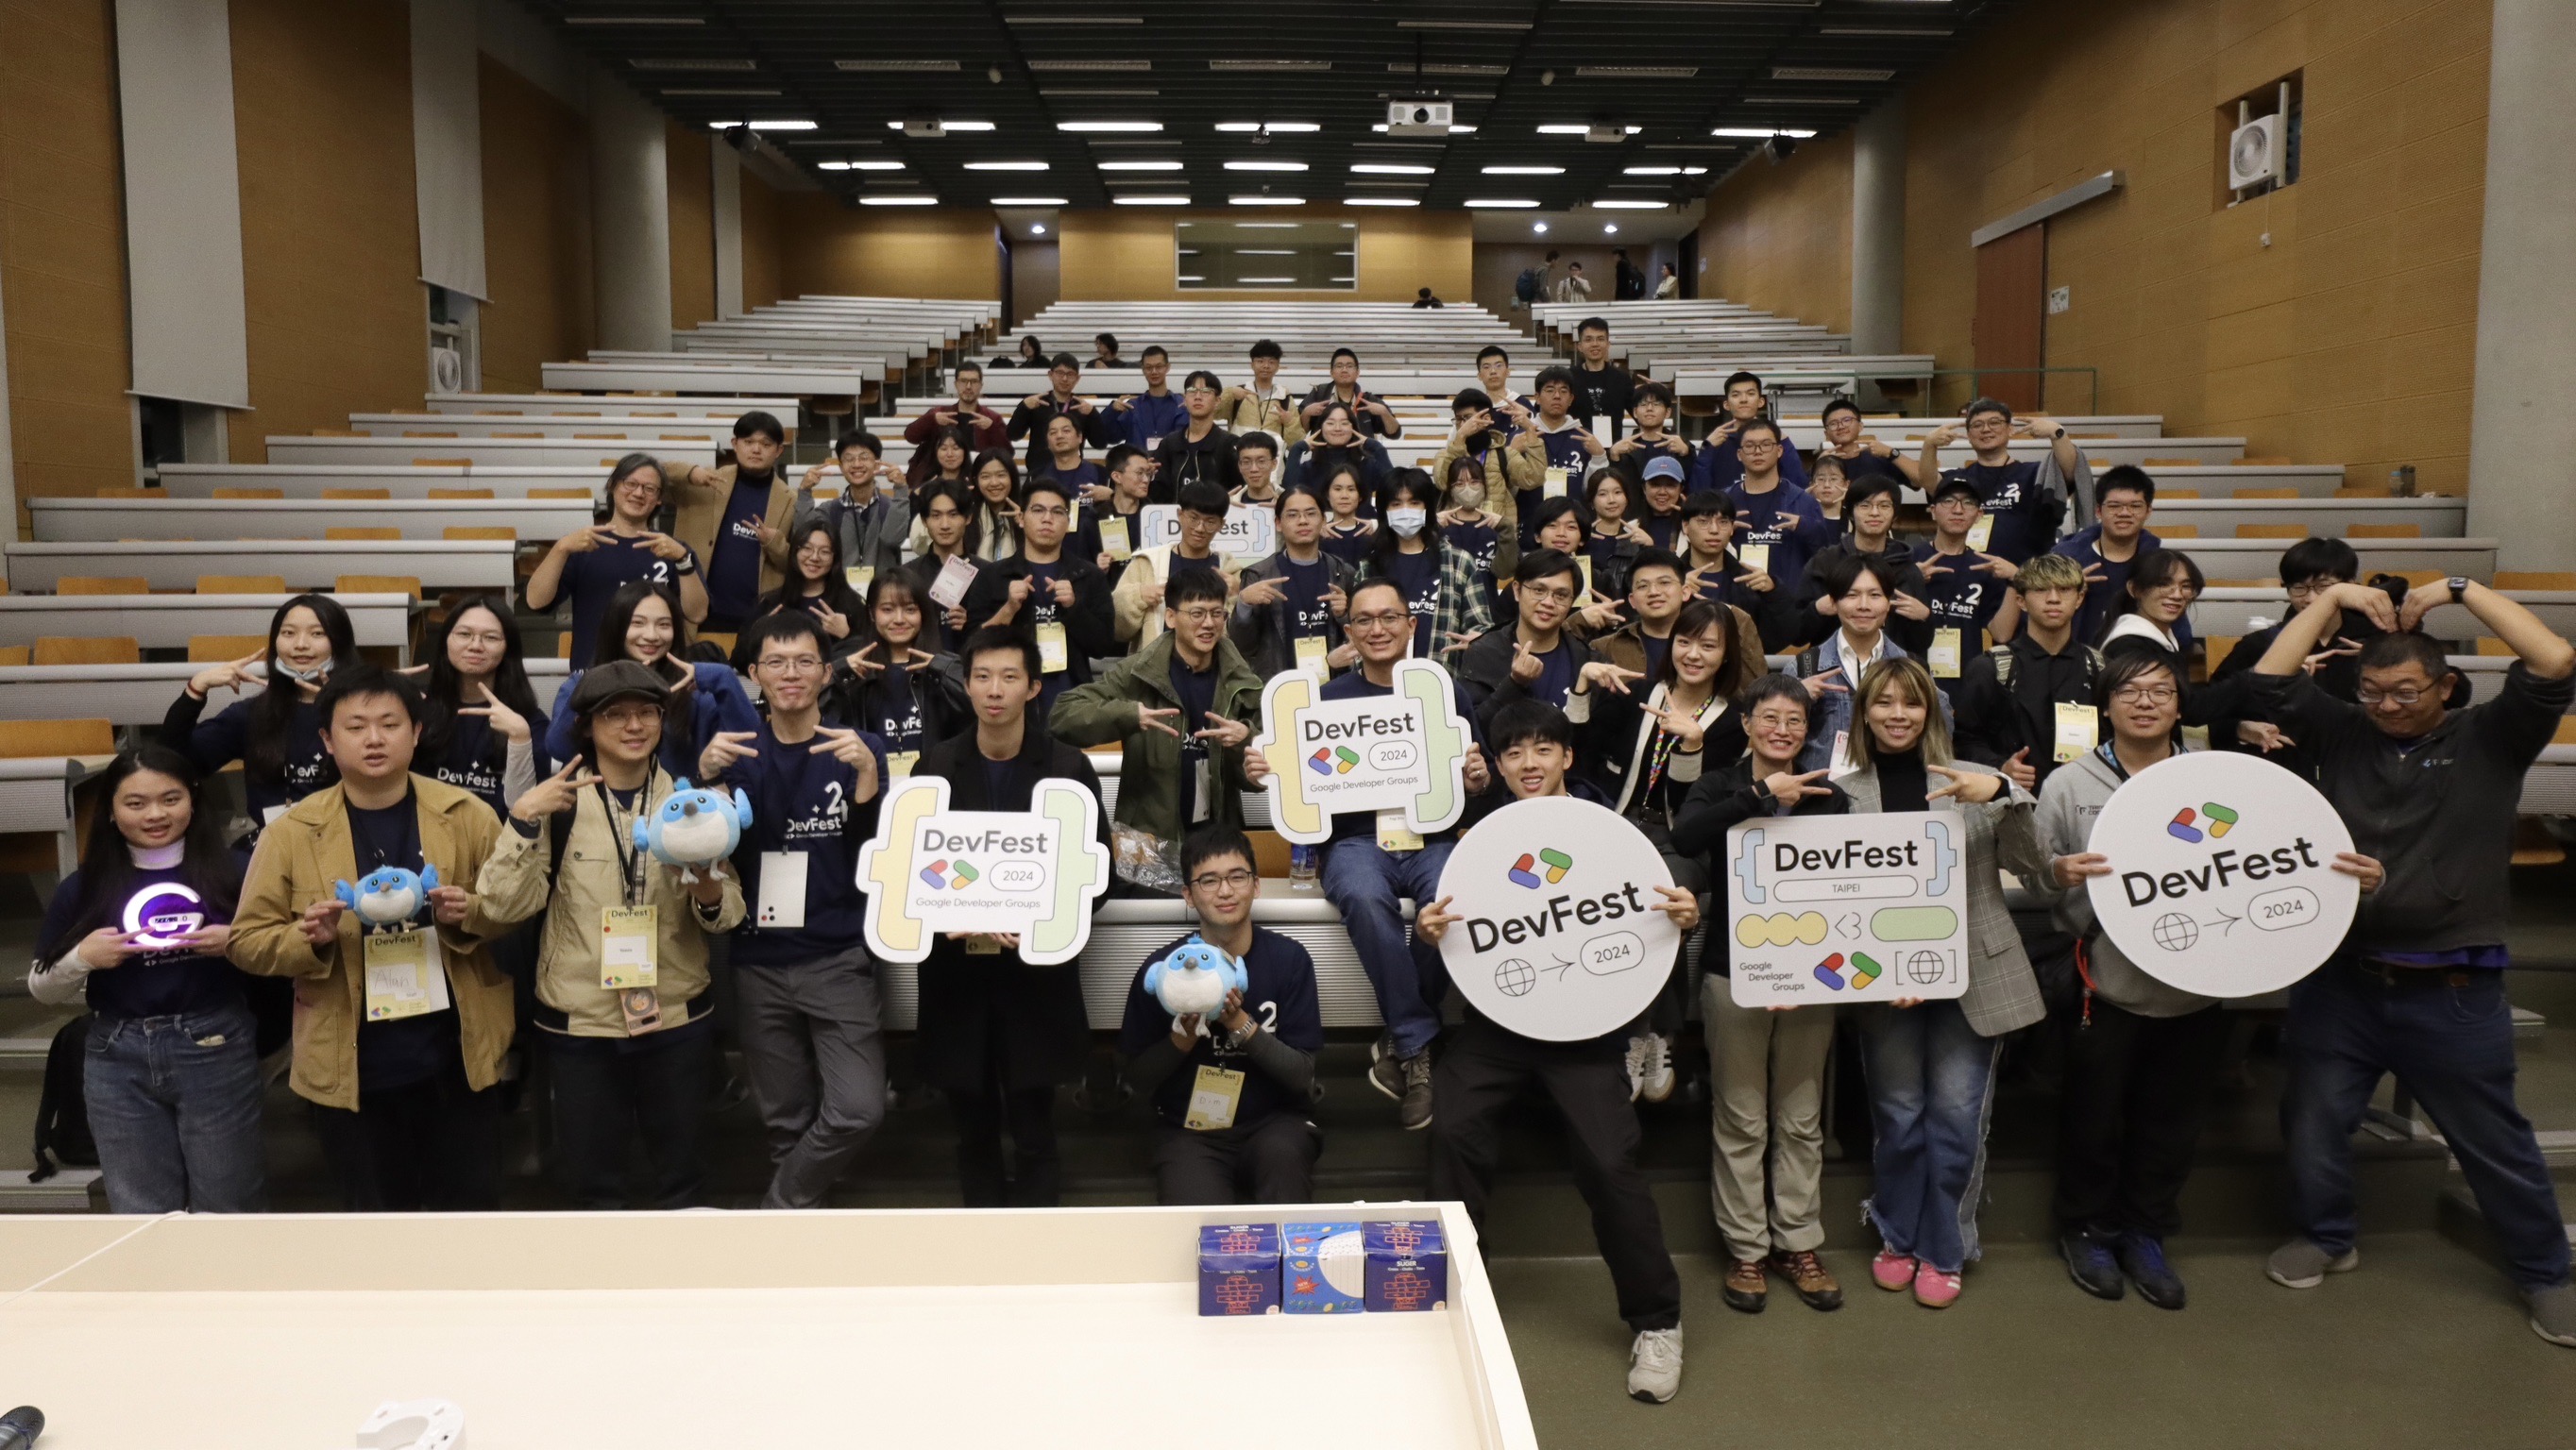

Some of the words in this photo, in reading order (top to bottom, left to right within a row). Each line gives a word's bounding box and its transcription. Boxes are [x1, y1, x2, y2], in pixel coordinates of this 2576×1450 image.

[1986, 497, 2012, 506] evFest
[1168, 518, 1249, 536] Dest
[1409, 598, 1435, 611] evFes
[1305, 713, 1415, 742] DevFest
[1381, 750, 1408, 762] 2024
[1310, 783, 1342, 794] Google
[1343, 780, 1385, 790] Developer
[1387, 776, 1419, 786] Groups
[924, 829, 1048, 853] DevFest
[1775, 840, 1919, 872] DevFest
[1003, 869, 1034, 882] 2024
[2122, 837, 2320, 907] DevFest
[1832, 884, 1861, 893] TAIPEI
[916, 897, 952, 908] Google
[954, 898, 1003, 908] Developer
[1005, 899, 1042, 909] Groups
[2263, 900, 2304, 919] 2024
[1466, 882, 1645, 953] DevFest
[1594, 944, 1631, 963] 2024
[1739, 961, 1772, 972] Google
[1748, 971, 1794, 983] Developer
[1771, 982, 1805, 992] Groups
